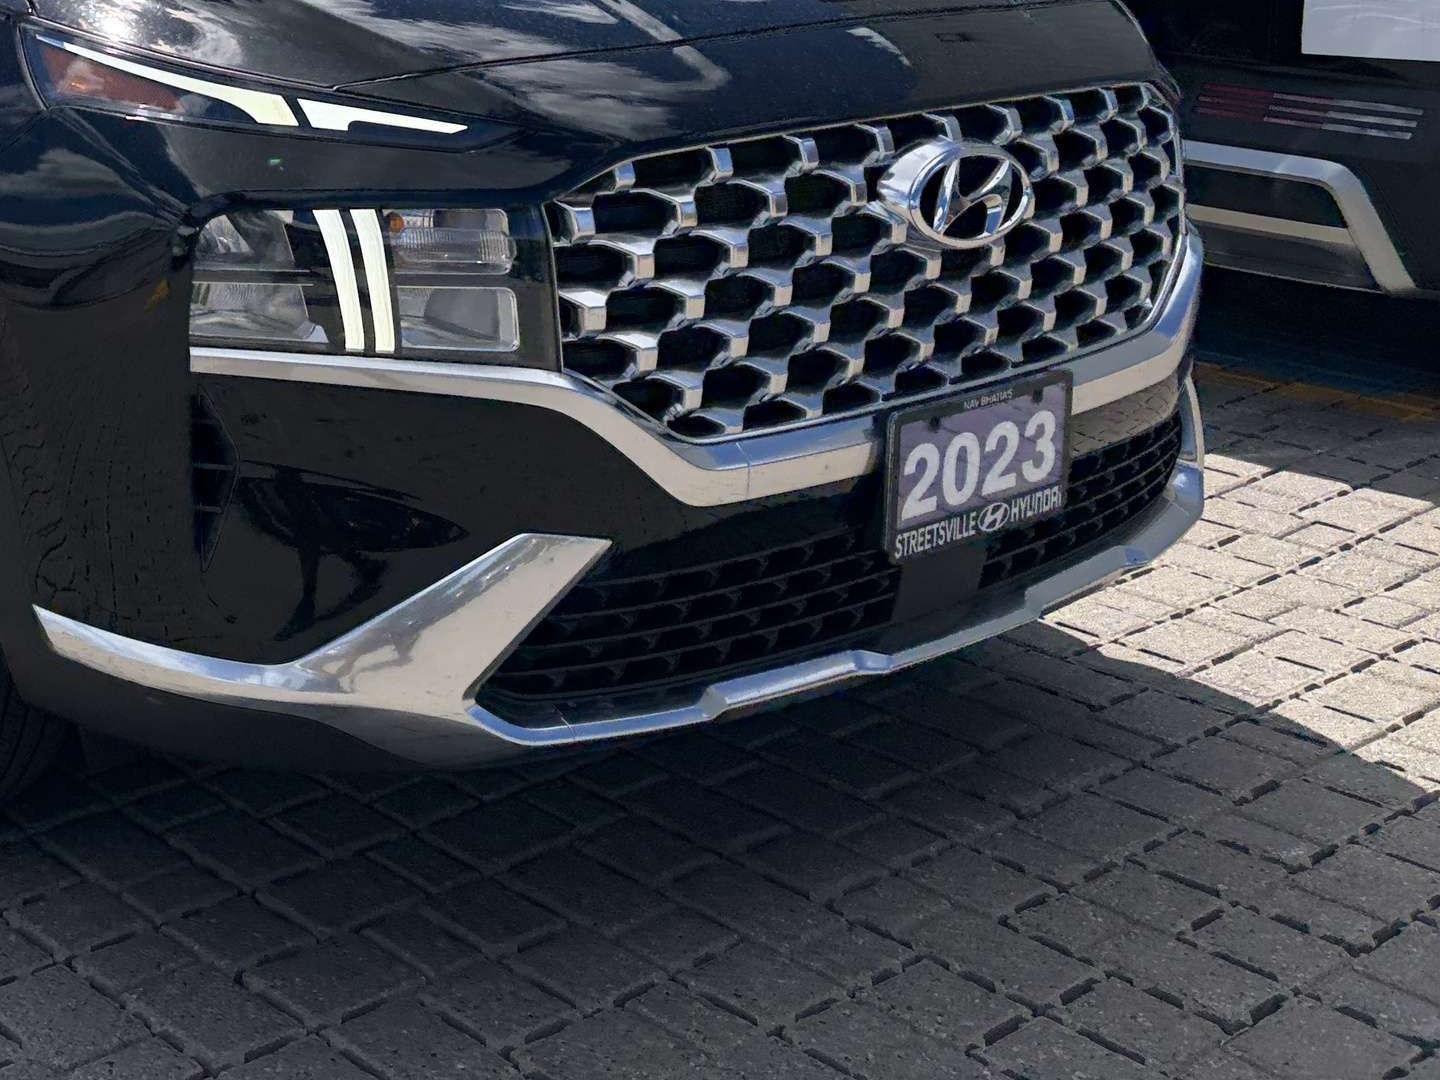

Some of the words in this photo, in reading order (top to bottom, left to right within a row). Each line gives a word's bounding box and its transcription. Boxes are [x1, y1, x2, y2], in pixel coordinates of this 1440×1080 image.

[901, 410, 1056, 521] 2023
[895, 512, 978, 559] STREETSVILLE
[1010, 485, 1062, 522] HYUNDAI
